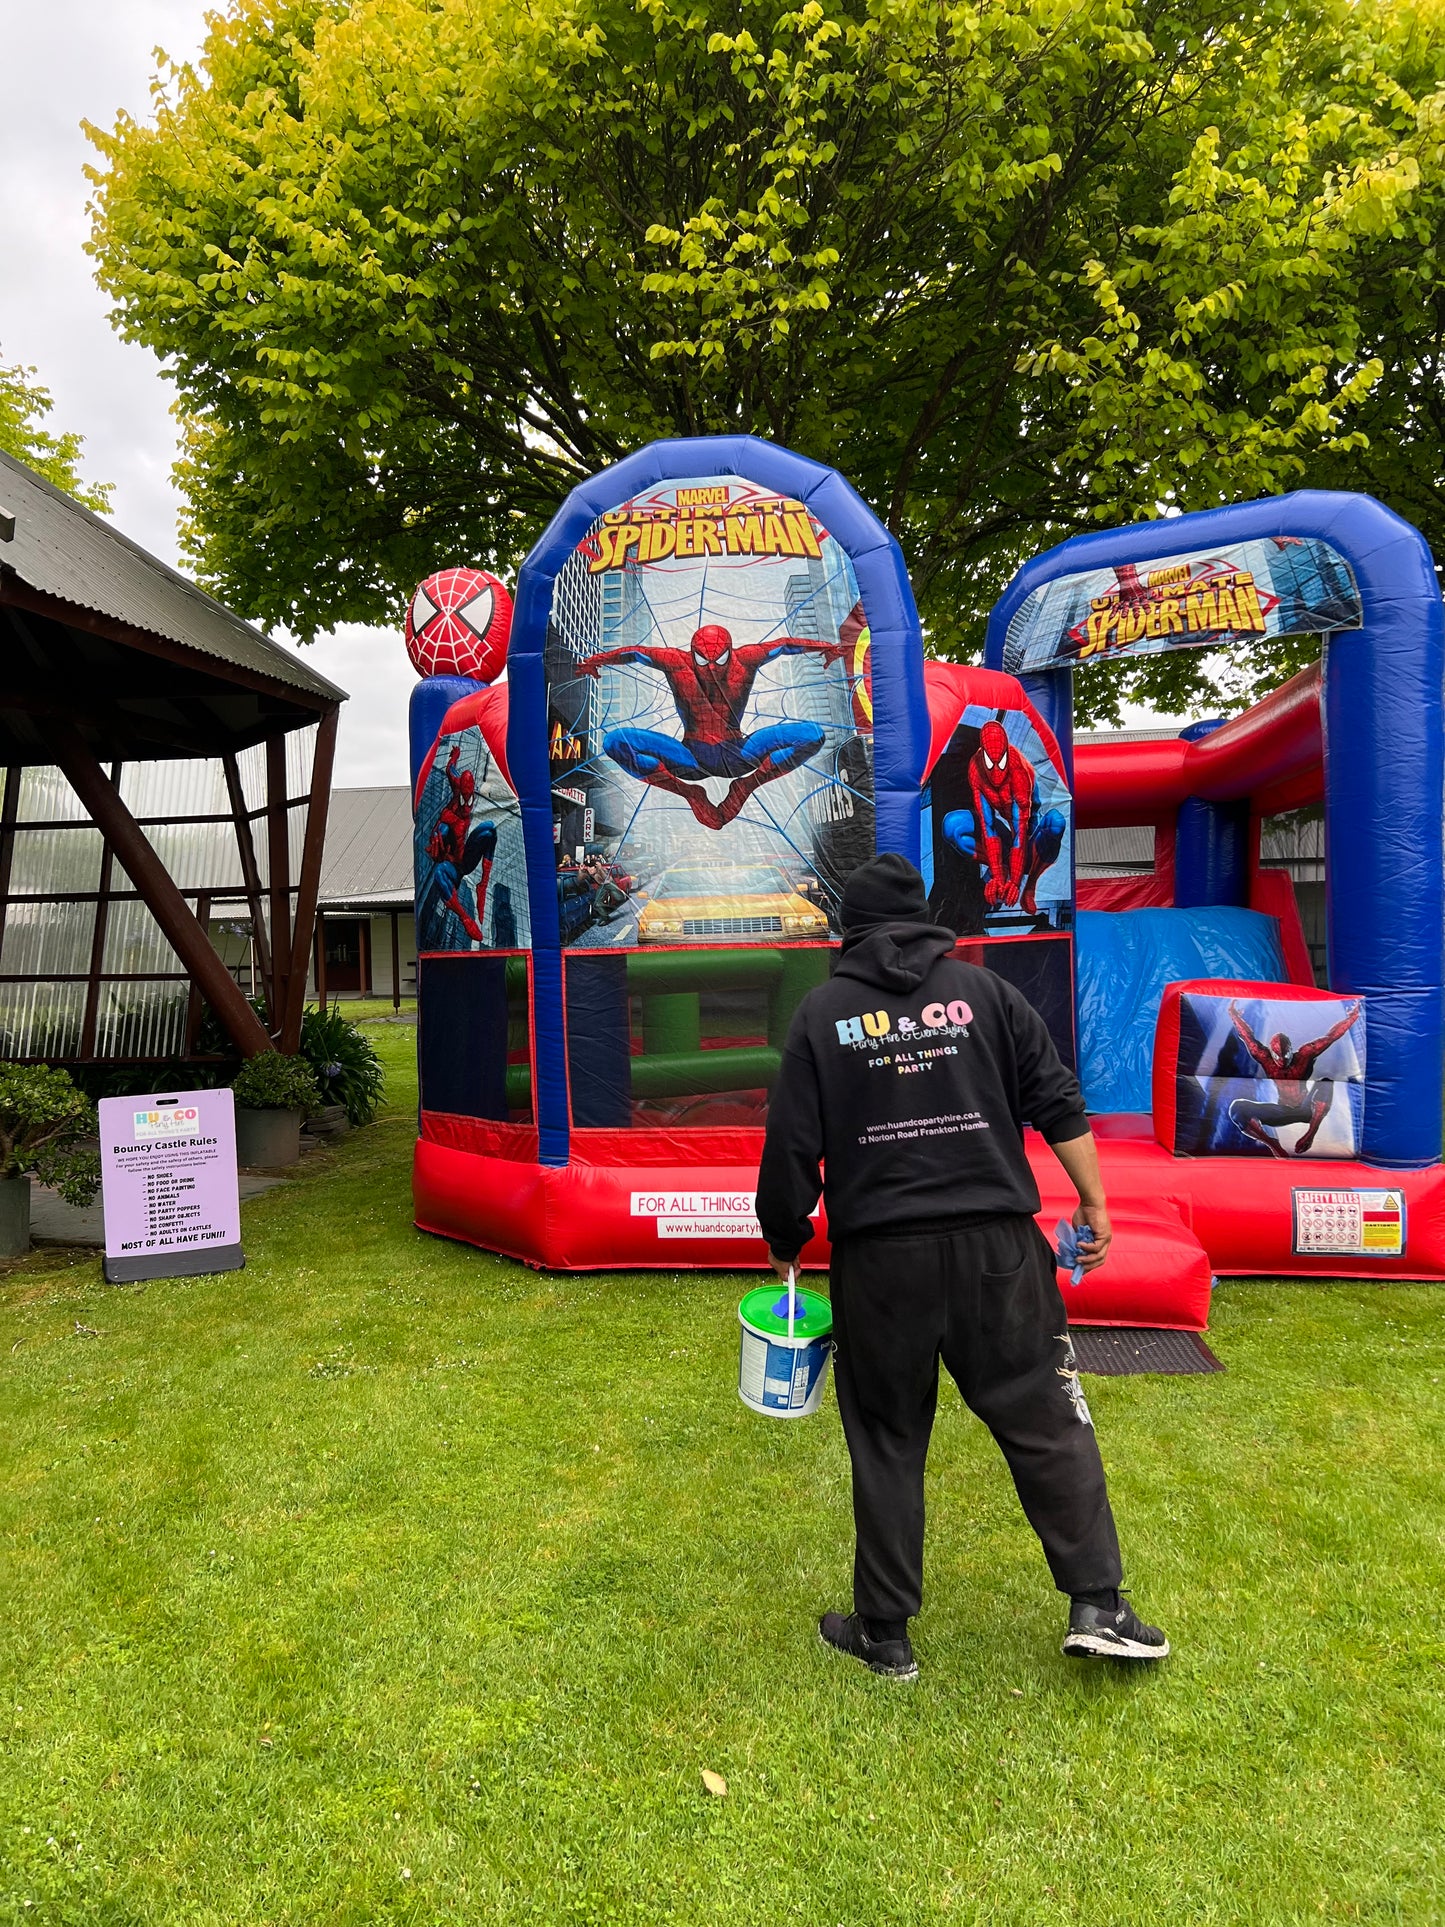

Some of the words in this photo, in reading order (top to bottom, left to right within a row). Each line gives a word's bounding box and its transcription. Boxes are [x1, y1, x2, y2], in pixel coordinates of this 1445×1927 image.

[677, 487, 729, 506] MARVEL
[602, 501, 806, 525] ULTIMATE
[588, 512, 823, 575] SPIDER-MAN
[1149, 564, 1191, 588] MARVEL
[1079, 585, 1266, 658] SPIDER-MAN
[835, 1010, 891, 1045] HU
[898, 1016, 917, 1032] &
[921, 1000, 973, 1028] CO
[850, 1036, 879, 1051] Party
[879, 1032, 900, 1045] Hire
[901, 1032, 911, 1041] &
[912, 1026, 939, 1040] Event
[938, 1024, 969, 1038] Styling
[868, 1056, 891, 1068] FOR
[894, 1052, 915, 1063] ALL
[916, 1046, 958, 1059] THINGS
[897, 1062, 933, 1074] PARTY
[136, 1112, 159, 1124] HU
[174, 1109, 196, 1120] CO
[858, 1136, 867, 1144] 12
[868, 1133, 896, 1143] Norton
[897, 1129, 919, 1139] Road
[920, 1125, 959, 1137] Frankton
[113, 1143, 152, 1154] Bouncy
[155, 1139, 187, 1150] Castle
[189, 1137, 218, 1146] Rules
[638, 1198, 666, 1212] FOR
[670, 1198, 697, 1212] ALL
[700, 1197, 751, 1212] THINGS
[1298, 1193, 1330, 1203] SAFETY
[1332, 1194, 1360, 1204] RULES
[121, 1241, 143, 1250] MOST
[176, 1234, 198, 1243] HAVE
[201, 1231, 226, 1241] FUN!!!
